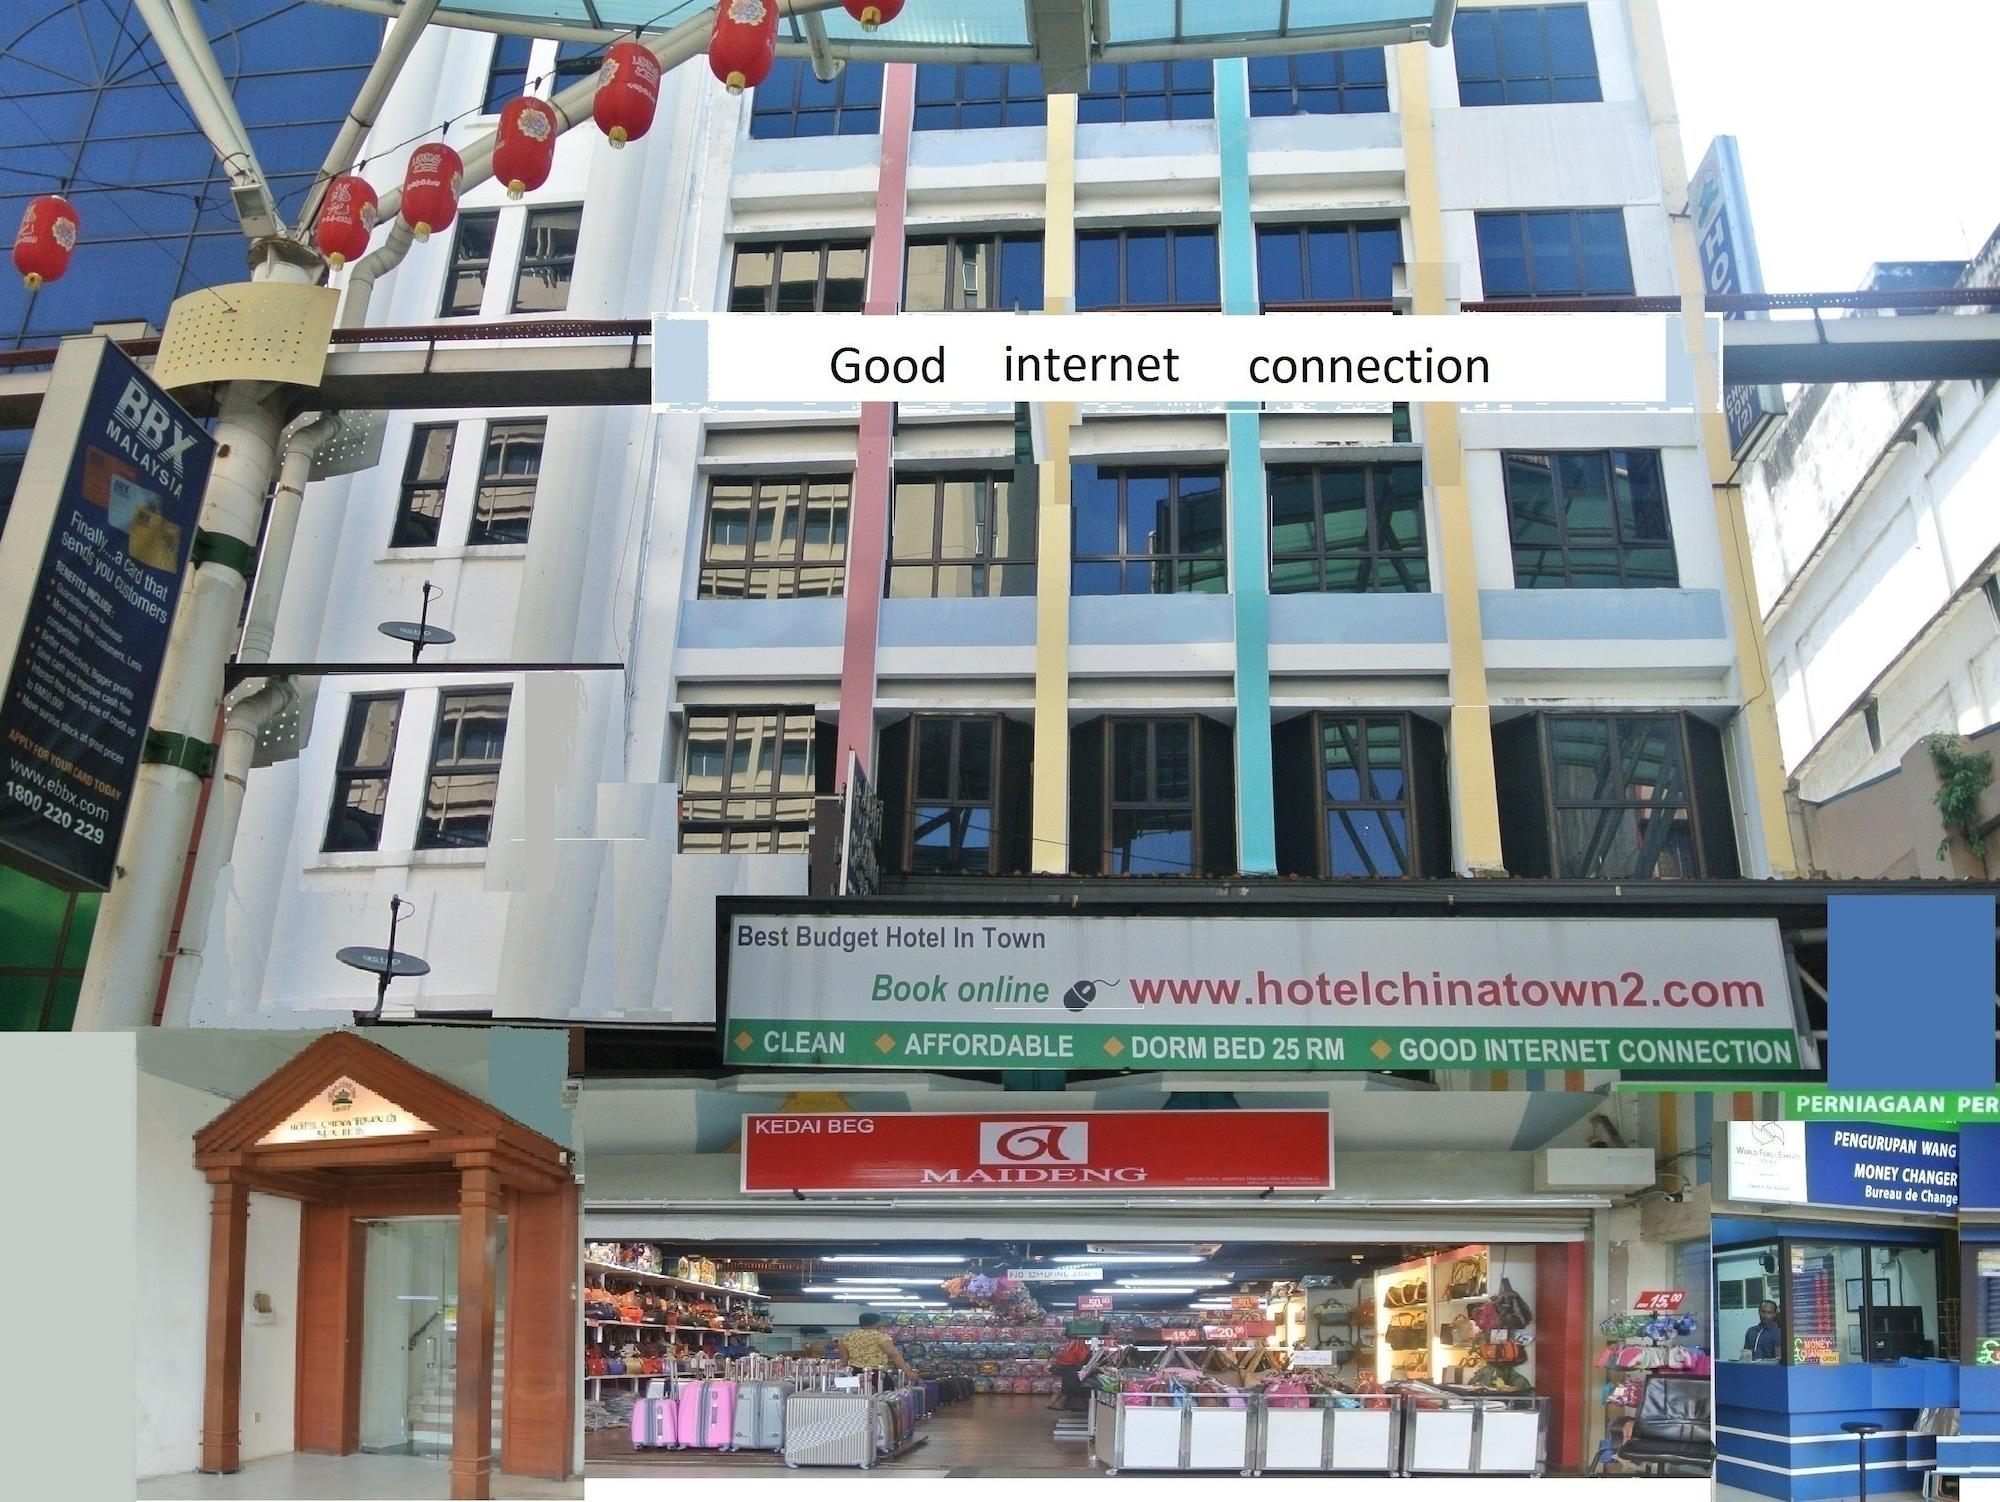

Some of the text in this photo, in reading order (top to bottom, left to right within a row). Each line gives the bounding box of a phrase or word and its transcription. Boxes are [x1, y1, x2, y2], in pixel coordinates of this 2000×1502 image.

[113, 376, 198, 479] BBX
[106, 420, 183, 500] MALAYSIA
[56, 560, 87, 593] BENEFITS
[61, 531, 168, 624] sends you customers
[123, 559, 143, 584] card
[144, 574, 168, 602] that
[52, 597, 67, 617] More
[101, 693, 119, 709] cash
[102, 710, 111, 720] of
[127, 726, 136, 737] up
[79, 733, 89, 744] at
[8, 729, 122, 801] APPLY FOR YOUR CARD TODAY
[10, 757, 109, 822] www.ebbx.com
[6, 781, 104, 845] 1800 220 229
[737, 925, 1046, 952] Best Budget Hotel In Town
[871, 974, 1049, 1003] Book online
[1129, 970, 1765, 1008] www.hotelchinatown2.com
[764, 1031, 845, 1054] CLEAN
[904, 1033, 1074, 1058] AFFORDABLE
[1131, 1035, 1345, 1061] DORM BED 25 RM
[1399, 1038, 1793, 1064] GOOD INTERNET CONNECTION
[1797, 1095, 1999, 1113] PERNIAGAAN PER
[755, 1119, 874, 1134] KEDAI BEG
[1833, 1130, 1957, 1159] PENGURUPAN WANG
[920, 1167, 1148, 1184] MAIDENG
[1854, 1163, 1958, 1186] MONEY CHANGER
[1865, 1185, 1958, 1207] Bureau de Change
[1009, 1271, 1024, 1279] NO
